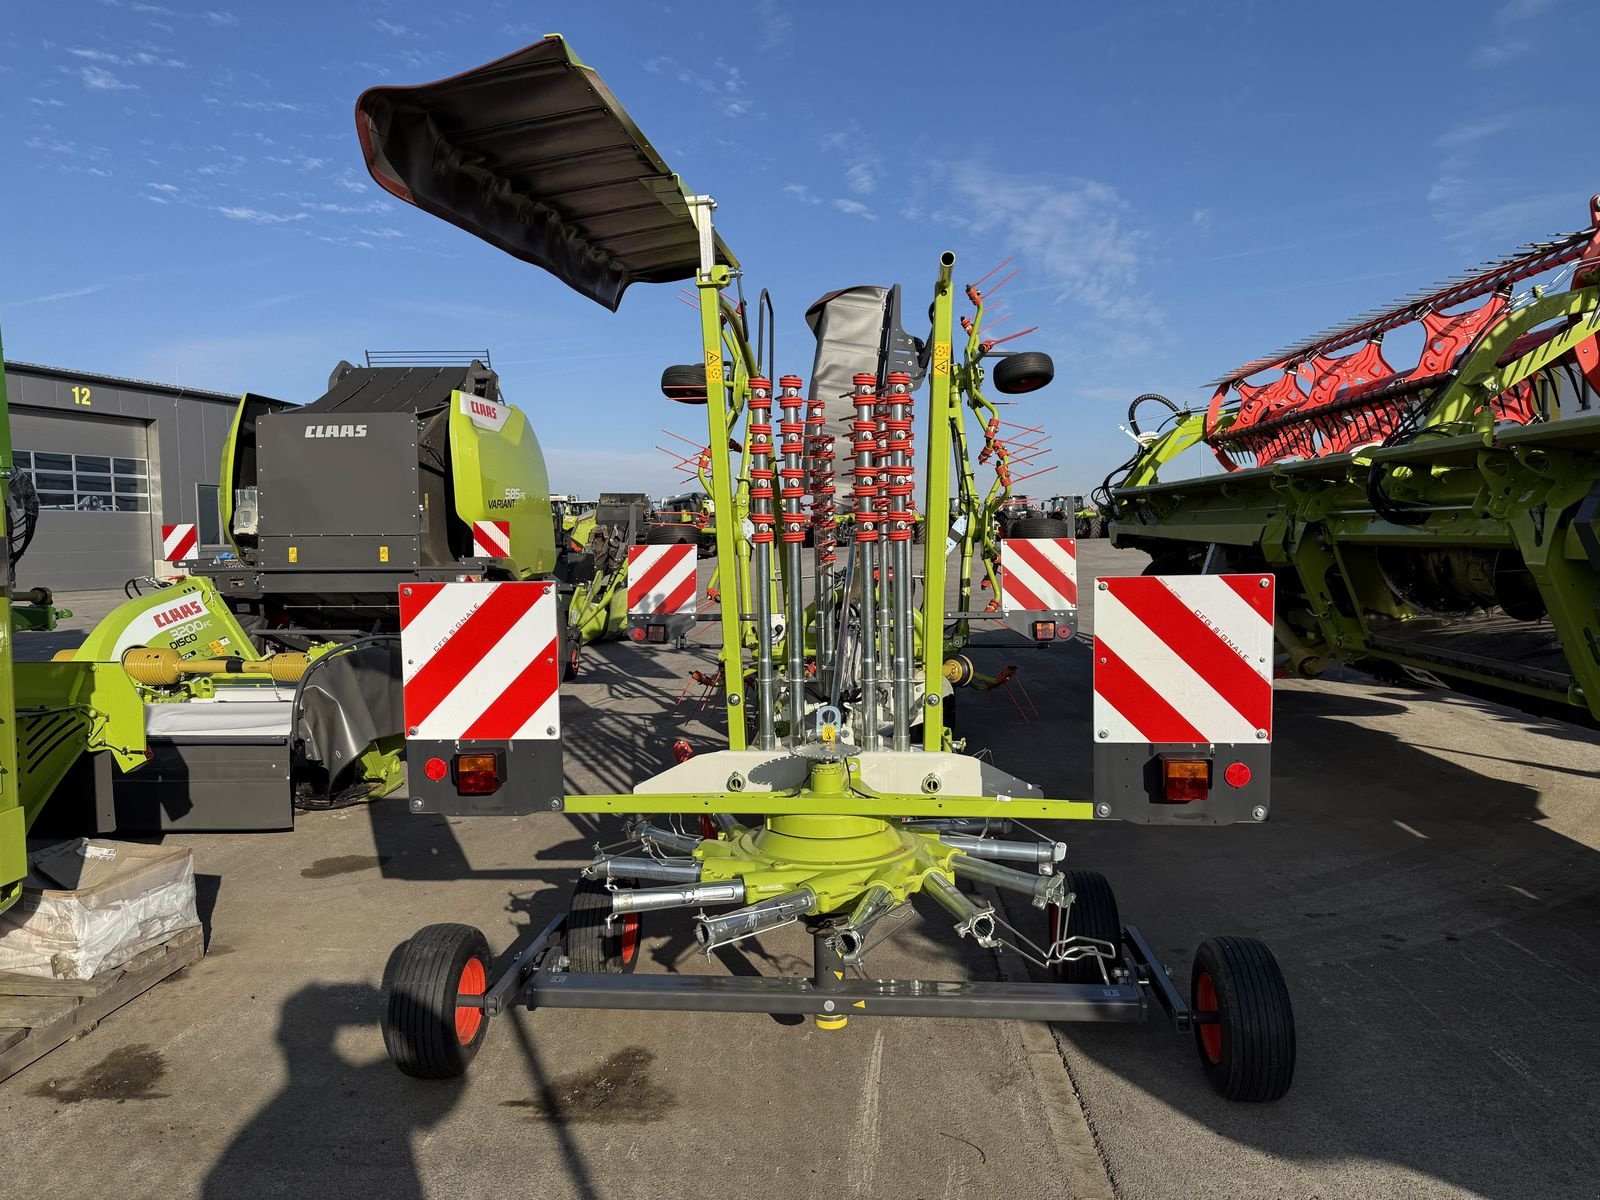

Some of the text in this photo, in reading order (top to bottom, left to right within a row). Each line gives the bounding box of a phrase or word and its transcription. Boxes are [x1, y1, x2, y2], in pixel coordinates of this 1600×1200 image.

[72, 386, 91, 406] 12
[471, 400, 497, 420] CLAAS
[304, 424, 368, 439] CLAAS
[487, 499, 515, 510] VARIANT
[153, 600, 203, 629] CLAAS
[1194, 609, 1212, 626] CFG
[168, 633, 198, 650] DISCO
[433, 636, 449, 653] CFG
